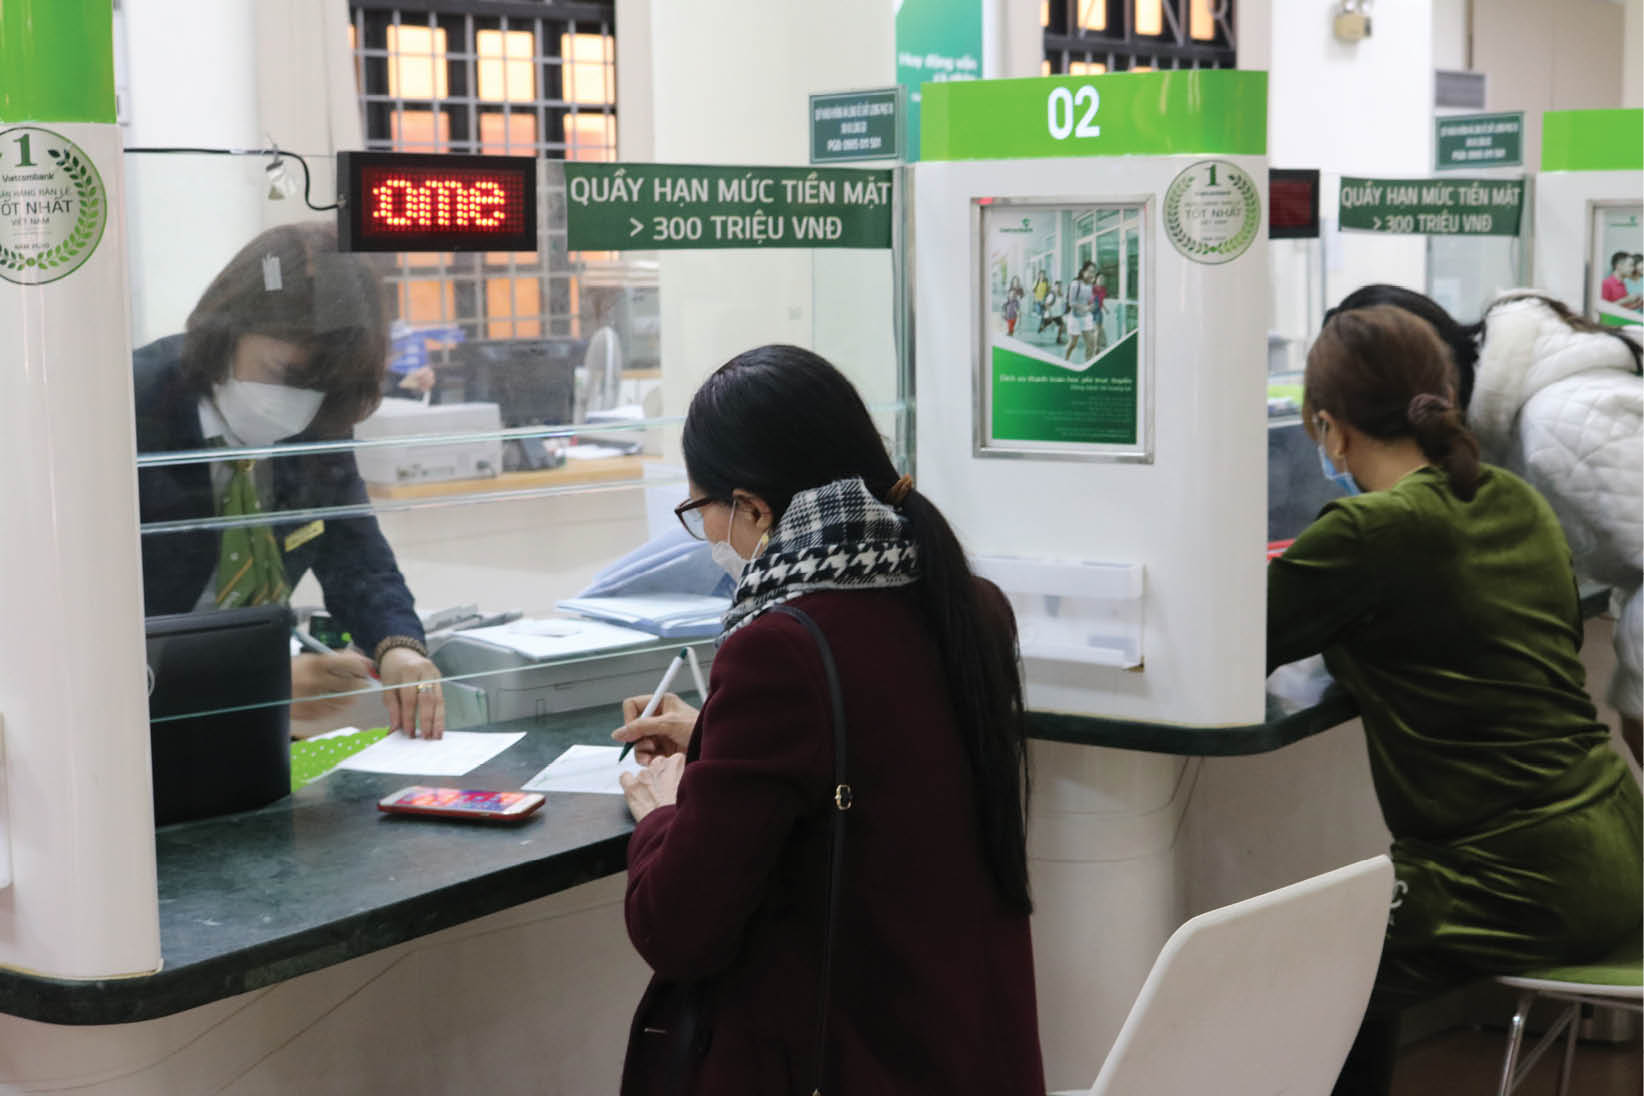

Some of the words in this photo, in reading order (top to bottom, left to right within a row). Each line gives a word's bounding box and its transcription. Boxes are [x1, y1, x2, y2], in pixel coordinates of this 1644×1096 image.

[1047, 85, 1100, 139] 02
[13, 133, 38, 168] 1
[653, 178, 709, 208] HẠN
[717, 172, 775, 204] MỨC
[843, 175, 892, 210] MẶT
[1204, 164, 1220, 187] 1
[26, 194, 73, 215] NHẤT
[653, 216, 703, 241] 300
[710, 208, 785, 245] TRIỆU
[791, 216, 843, 241] VNĐ
[1385, 213, 1415, 233] 300
[1461, 213, 1493, 233] VNĐ
